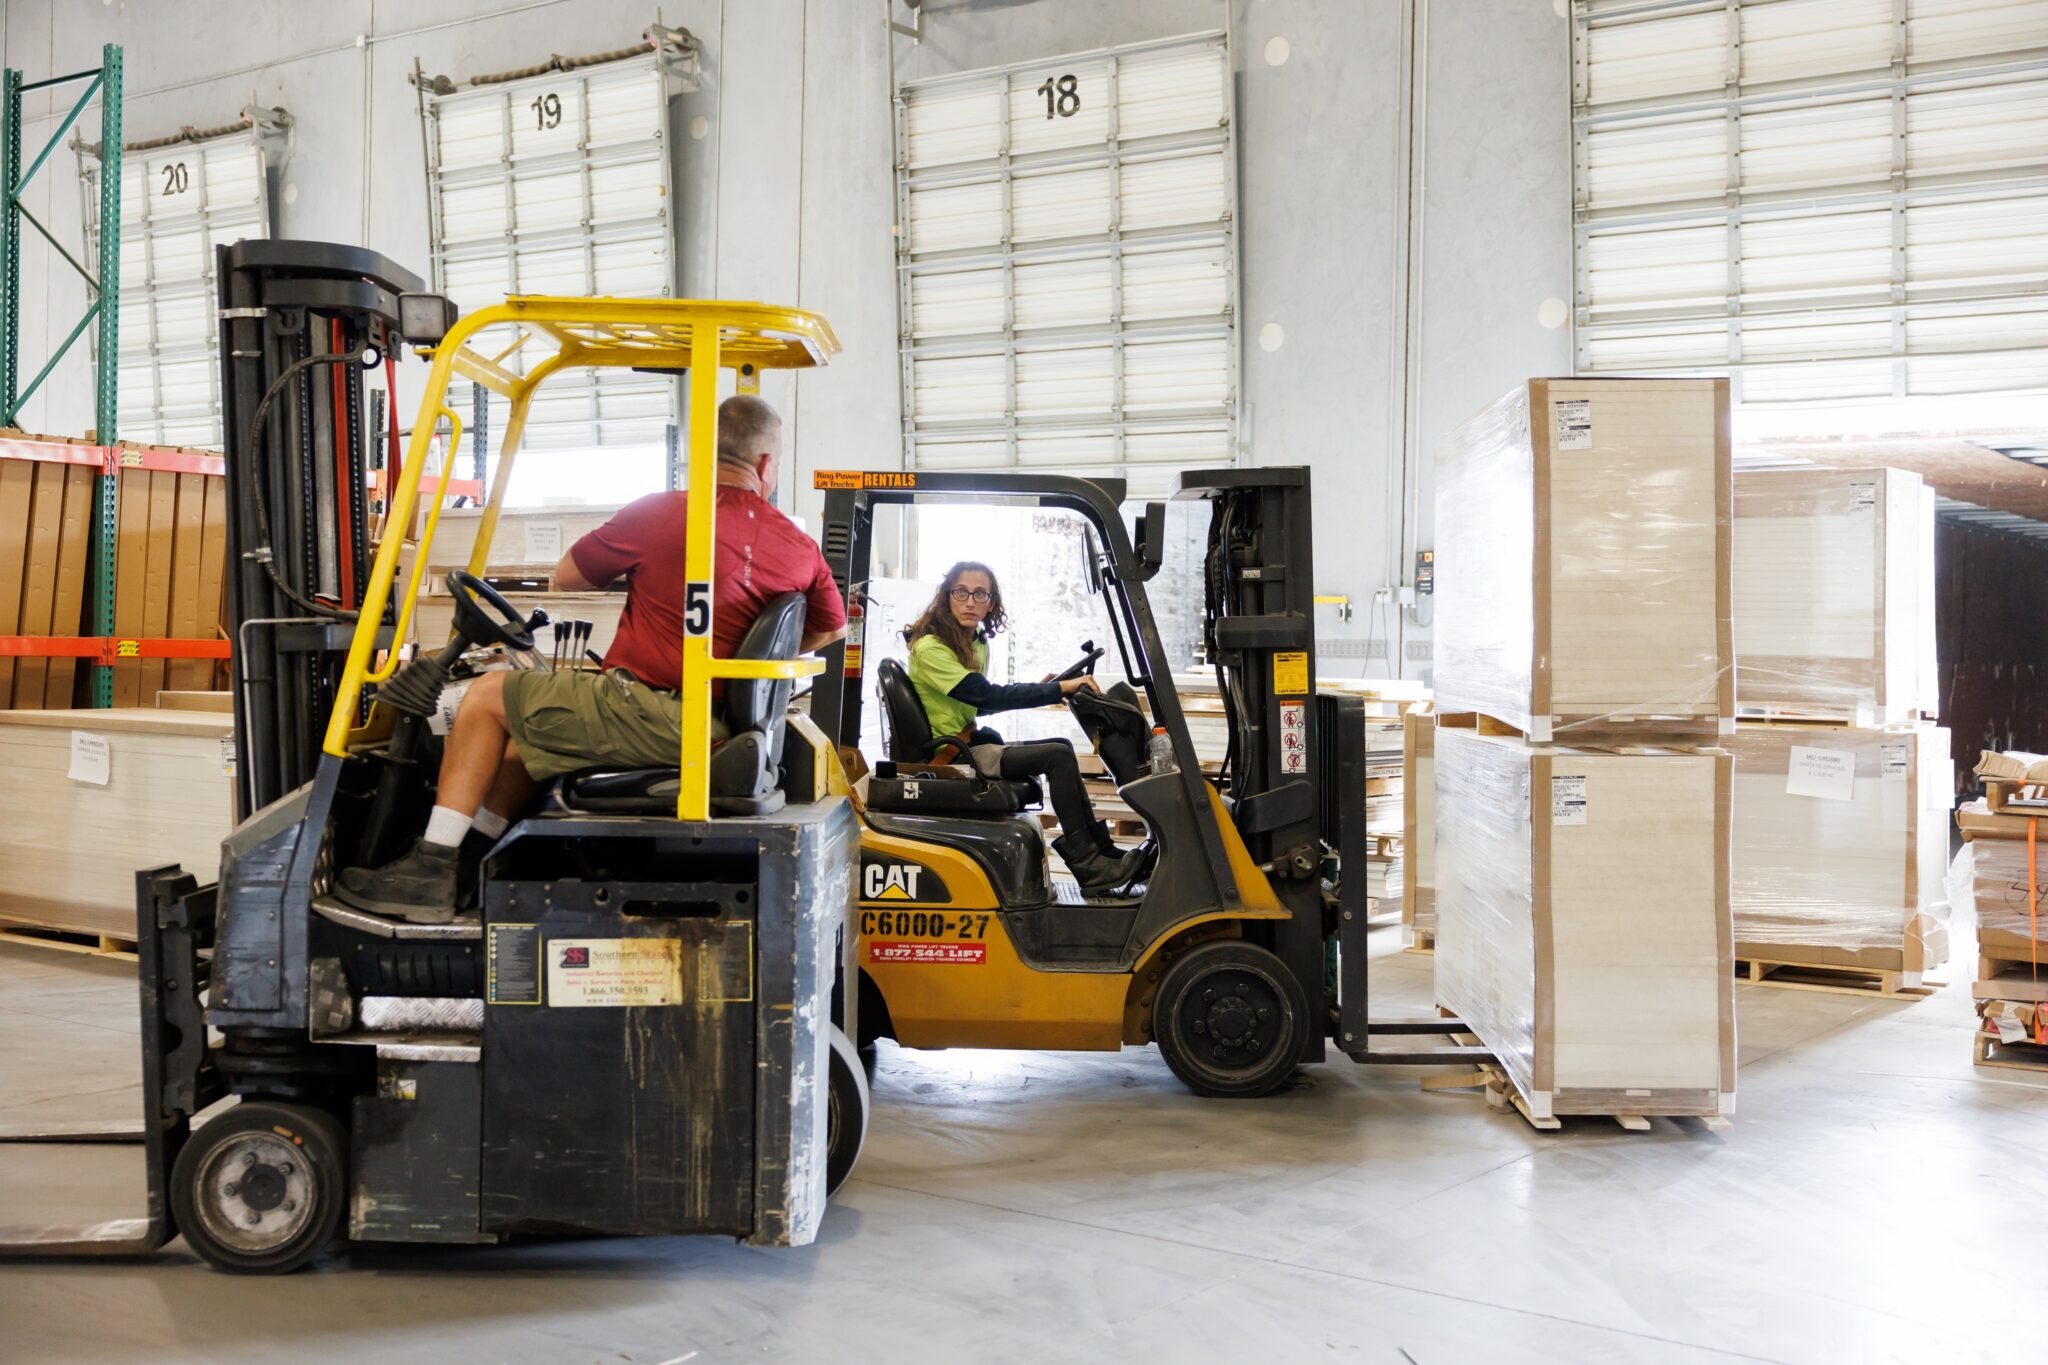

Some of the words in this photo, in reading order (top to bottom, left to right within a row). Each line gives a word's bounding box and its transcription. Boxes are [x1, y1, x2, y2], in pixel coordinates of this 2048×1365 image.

[531, 93, 562, 131] 19
[1037, 74, 1080, 120] 18
[161, 162, 188, 196] 20
[816, 472, 834, 480] Ring
[835, 472, 861, 480] Power
[864, 473, 916, 487] RENTALS
[685, 583, 710, 636] 5
[864, 863, 922, 899] CAT
[861, 911, 990, 939] C6000-27
[592, 950, 638, 961] Southern
[873, 948, 983, 958] 1-877-544-LIFT
